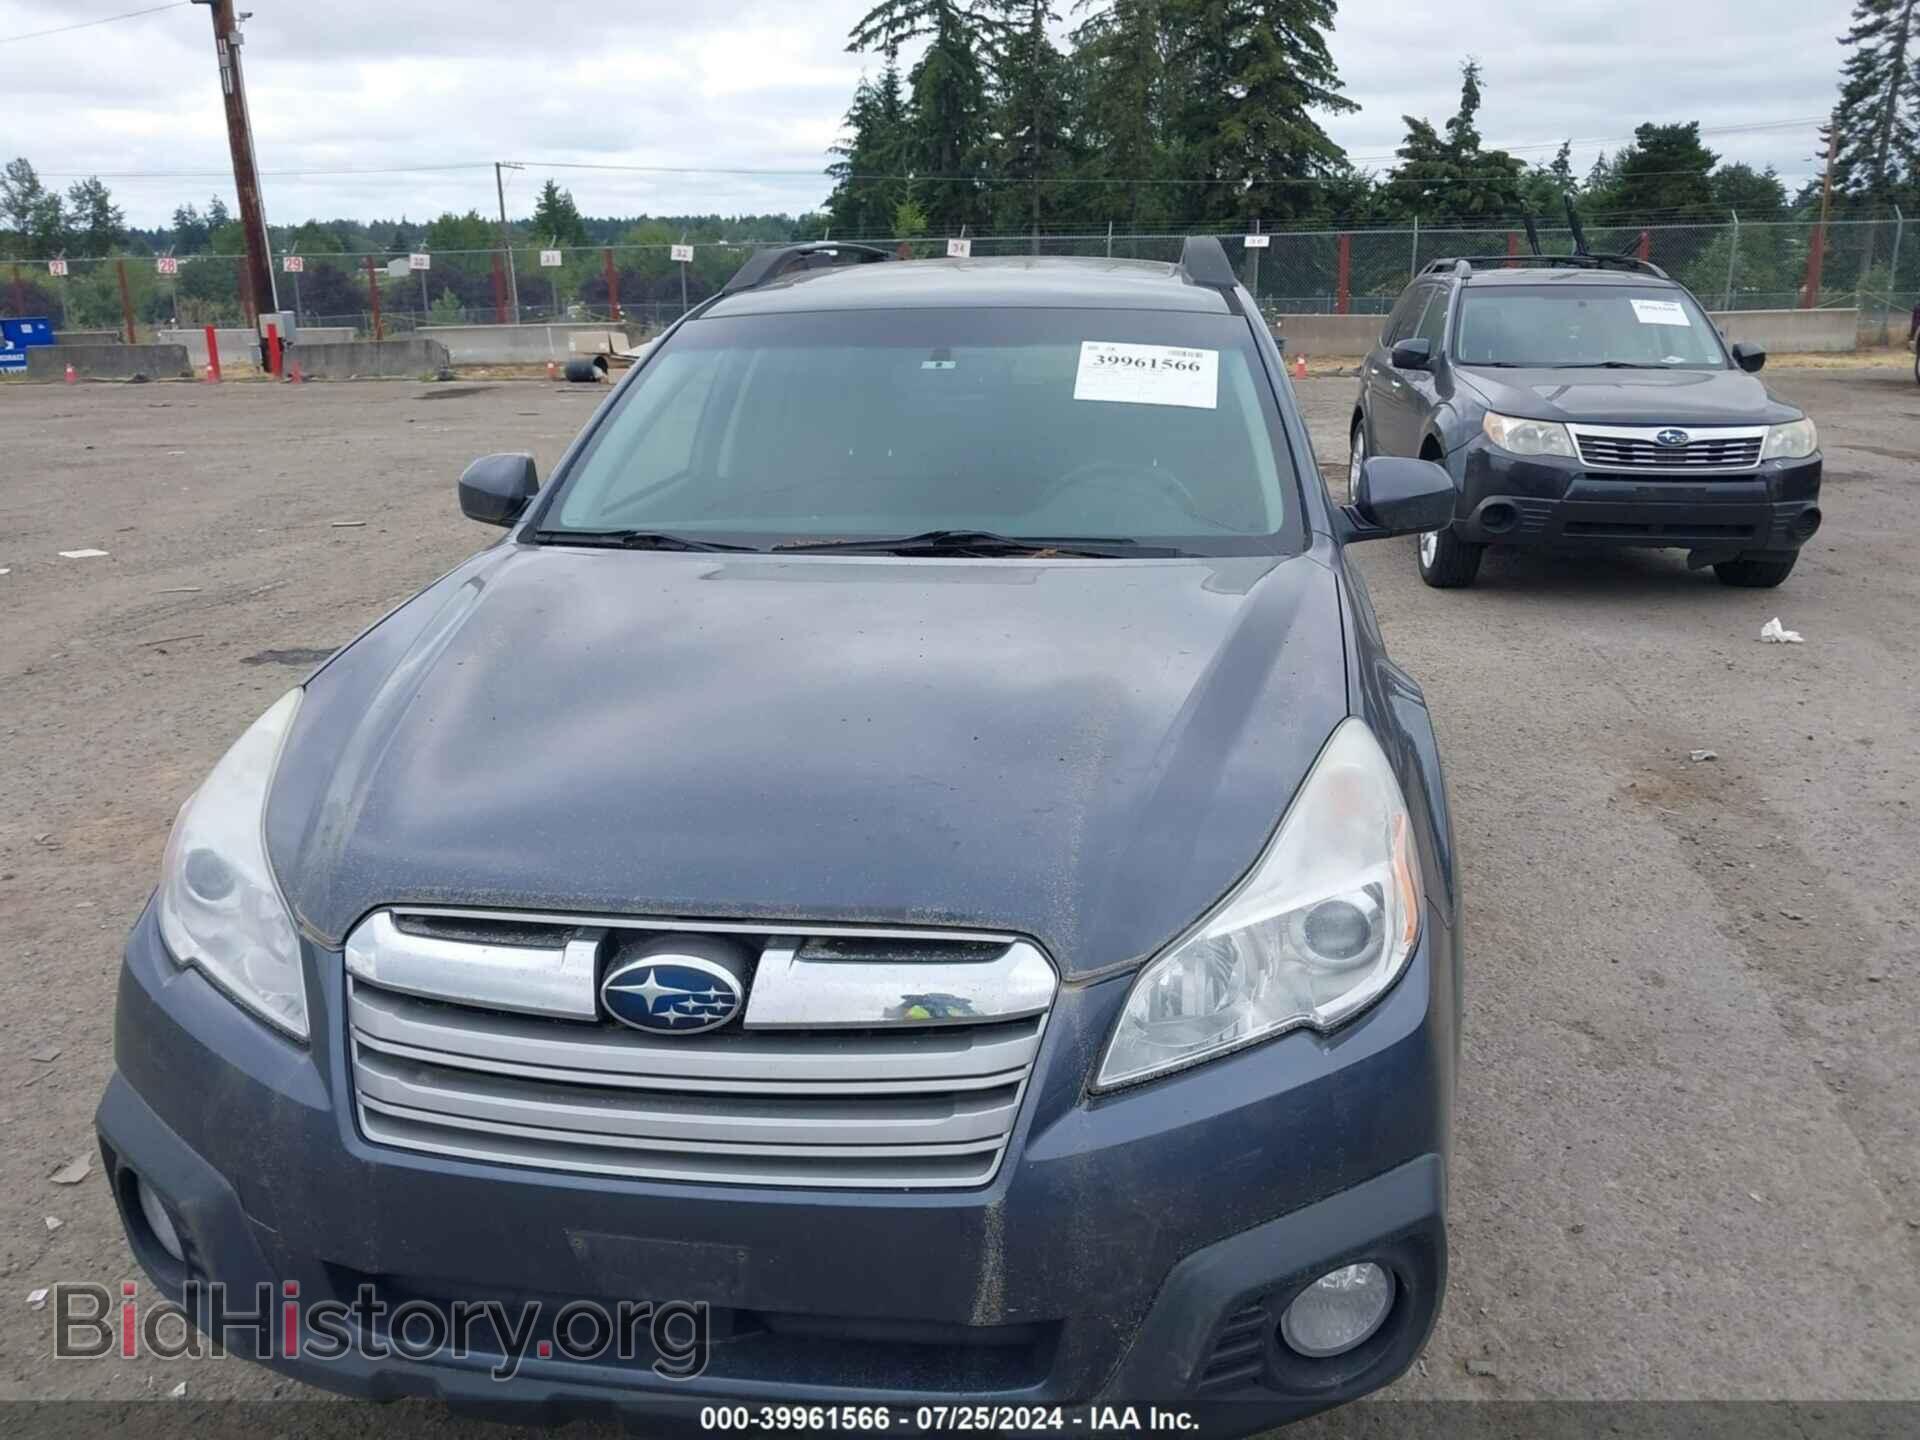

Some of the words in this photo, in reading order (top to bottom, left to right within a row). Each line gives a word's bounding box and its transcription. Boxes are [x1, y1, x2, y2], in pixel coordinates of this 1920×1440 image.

[51, 261, 65, 275] 27
[160, 259, 176, 272] 28
[286, 258, 302, 271] 29
[1093, 354, 1201, 372] 39961566
